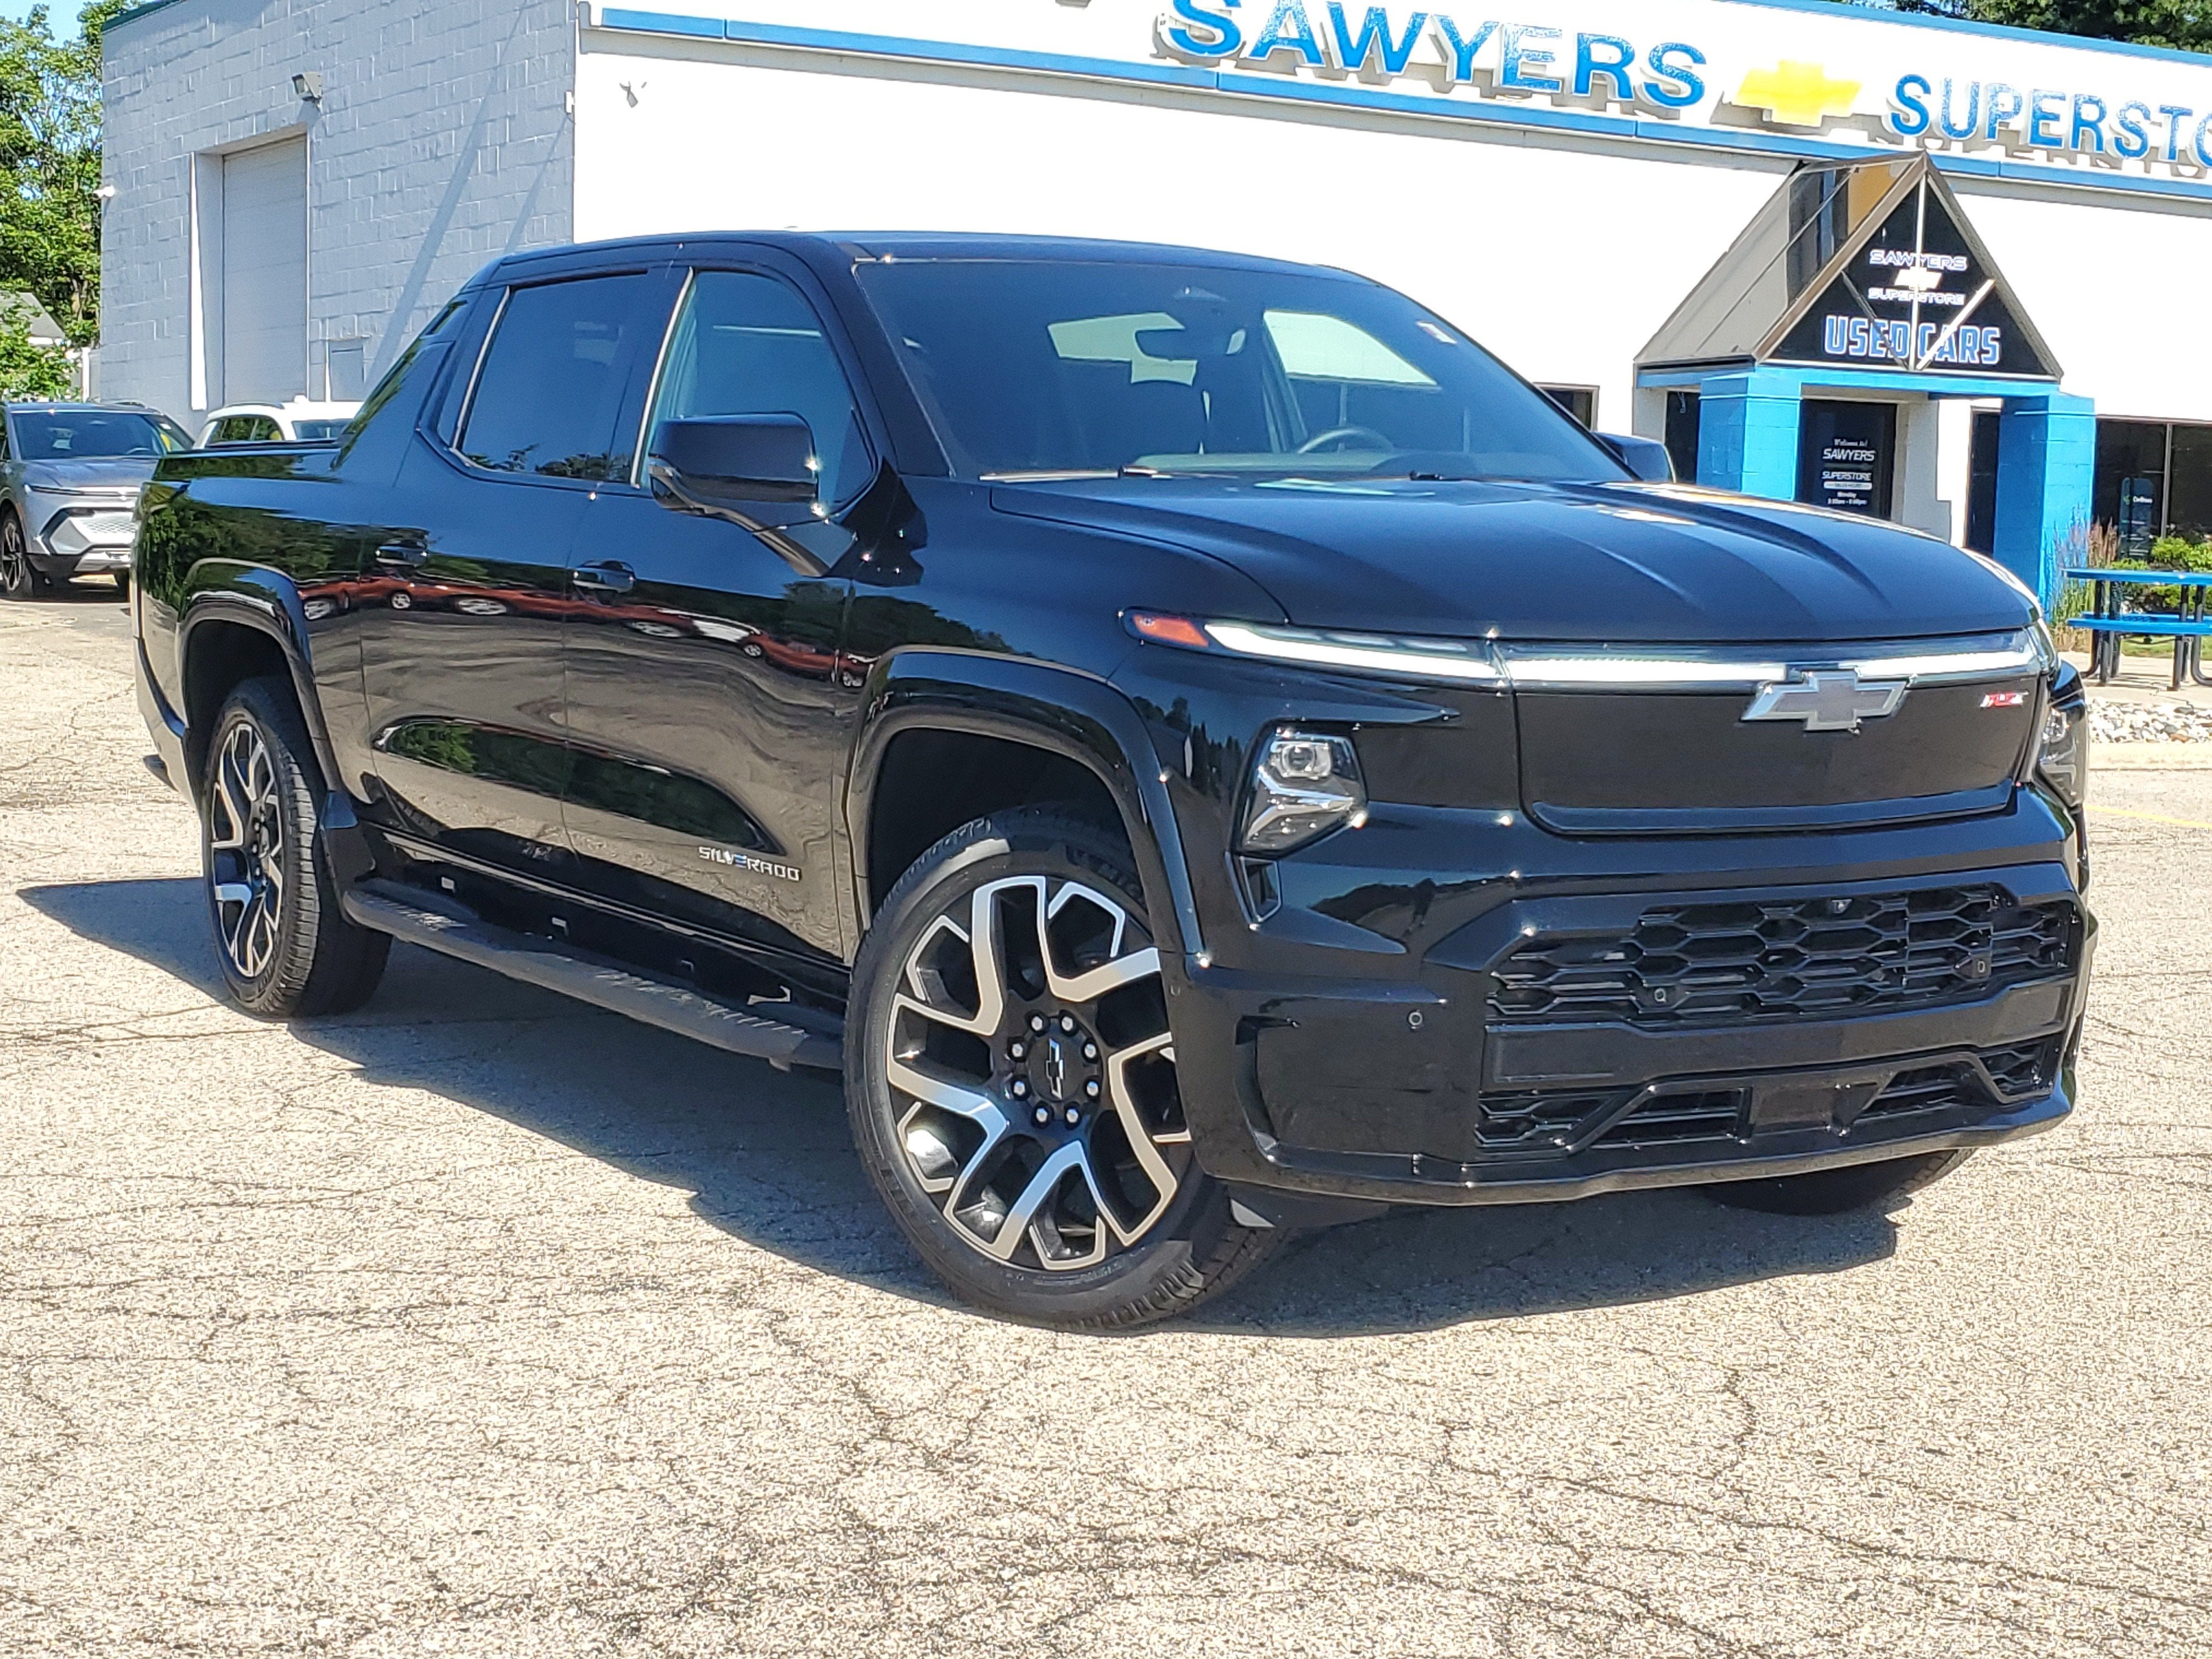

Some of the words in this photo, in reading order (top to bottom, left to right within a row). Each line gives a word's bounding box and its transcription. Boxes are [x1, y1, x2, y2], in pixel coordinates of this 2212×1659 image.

[1167, 0, 1707, 108] SAWYERS
[1869, 249, 1967, 271] SAWYERS
[1868, 287, 1965, 305] SUPERSTORE
[1825, 315, 1910, 358] USED
[1917, 323, 2000, 364] CARS
[1822, 448, 1876, 461] SAWYERS
[1821, 471, 1872, 481] SUPERSTORE
[698, 846, 801, 882] SILVERADO
